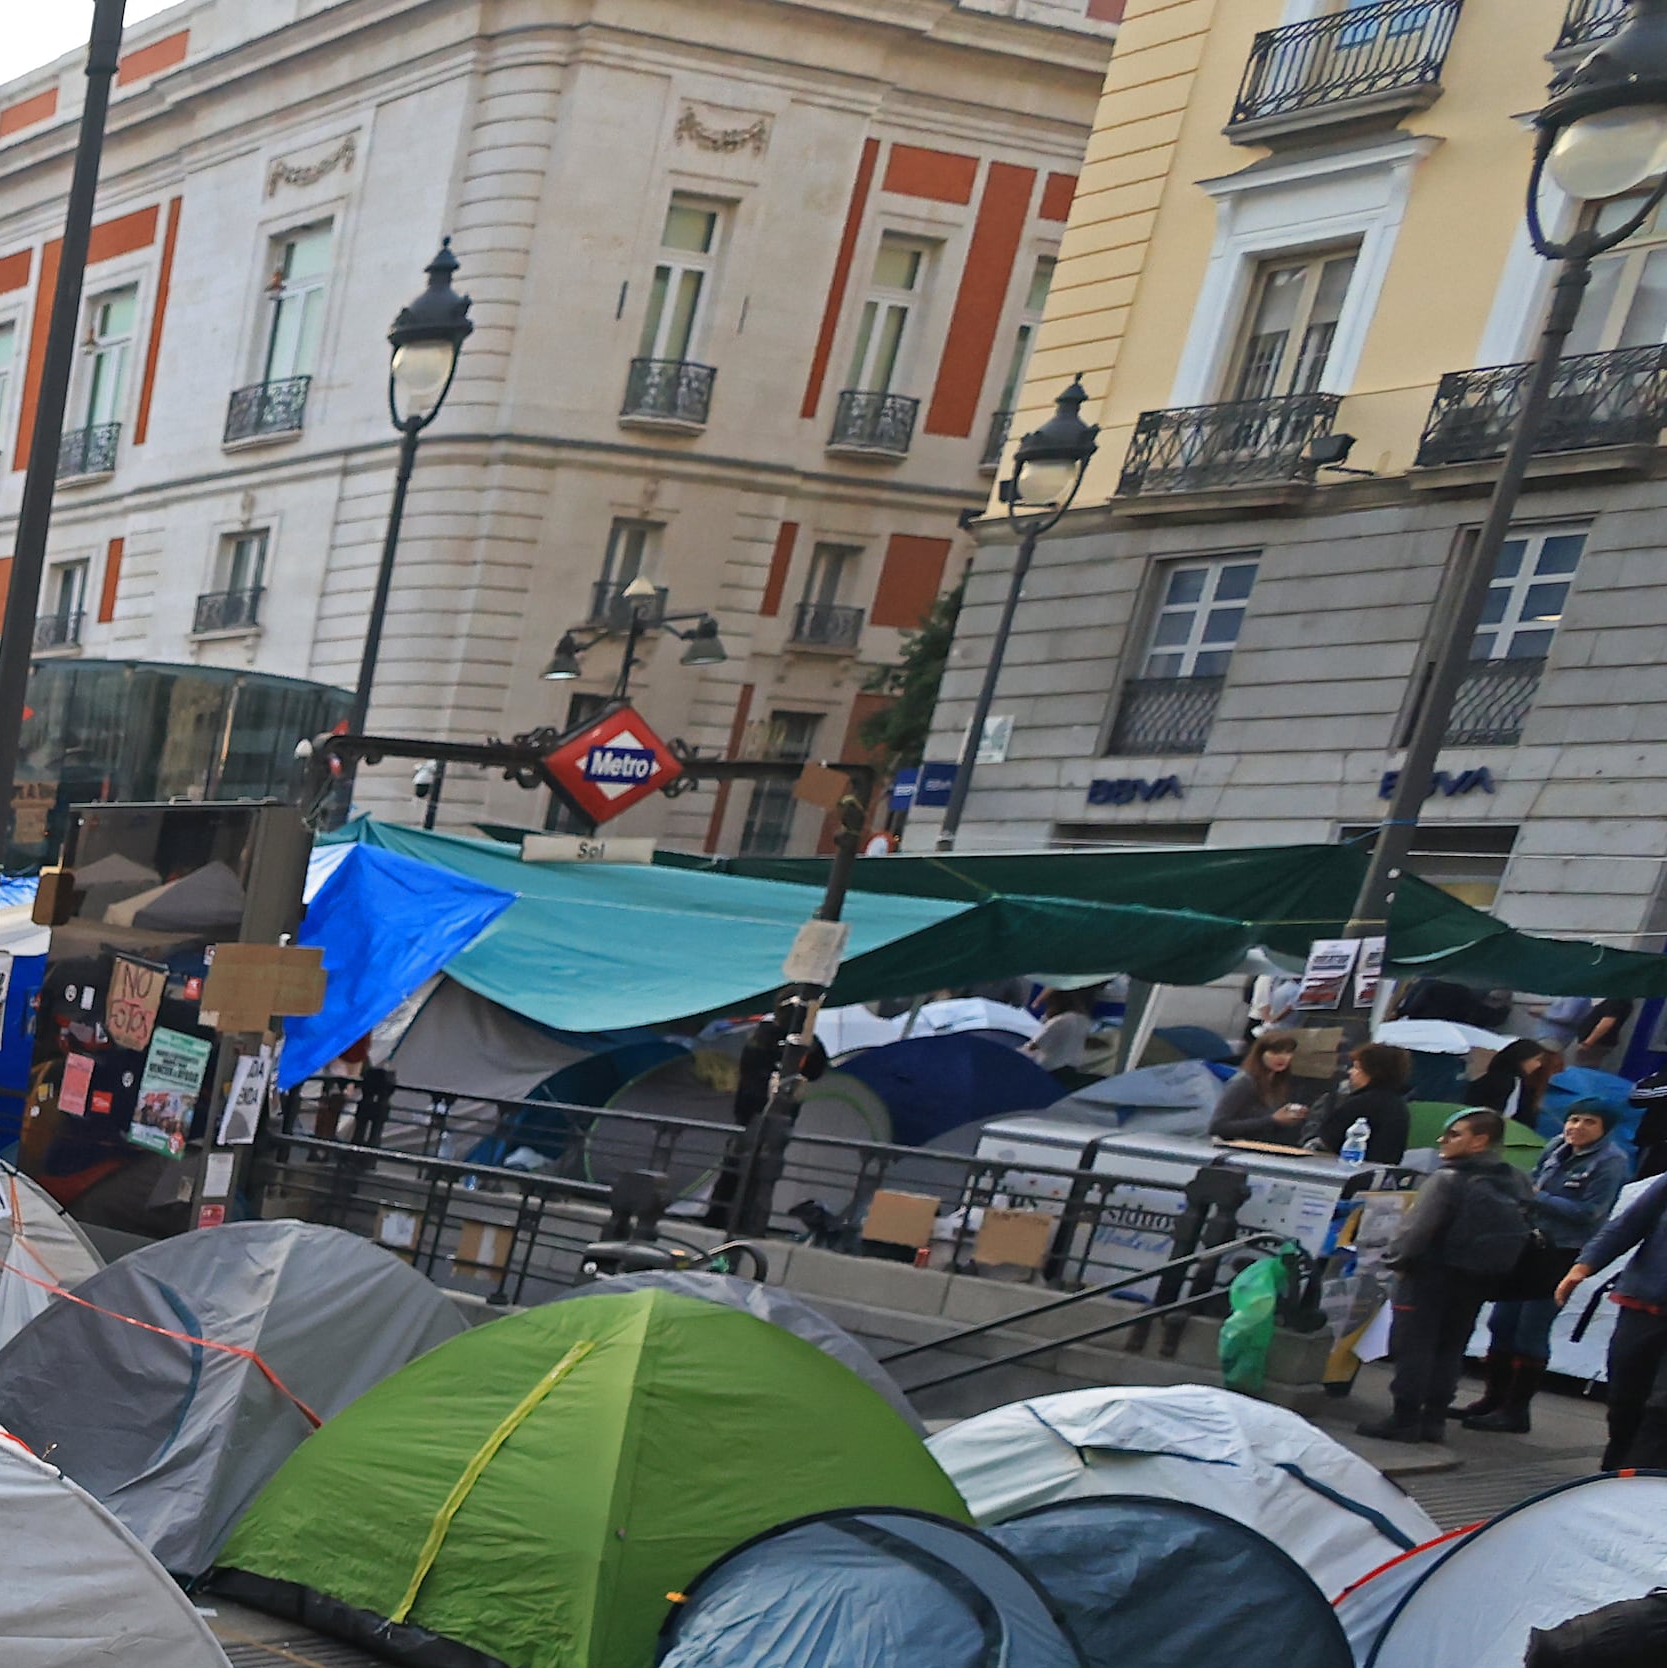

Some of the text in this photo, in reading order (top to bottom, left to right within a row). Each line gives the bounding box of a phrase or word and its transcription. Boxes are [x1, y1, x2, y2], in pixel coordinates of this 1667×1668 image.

[589, 750, 650, 778] Metro
[1086, 774, 1184, 805] BBVA
[577, 841, 605, 859] Sol
[122, 963, 154, 999] NO
